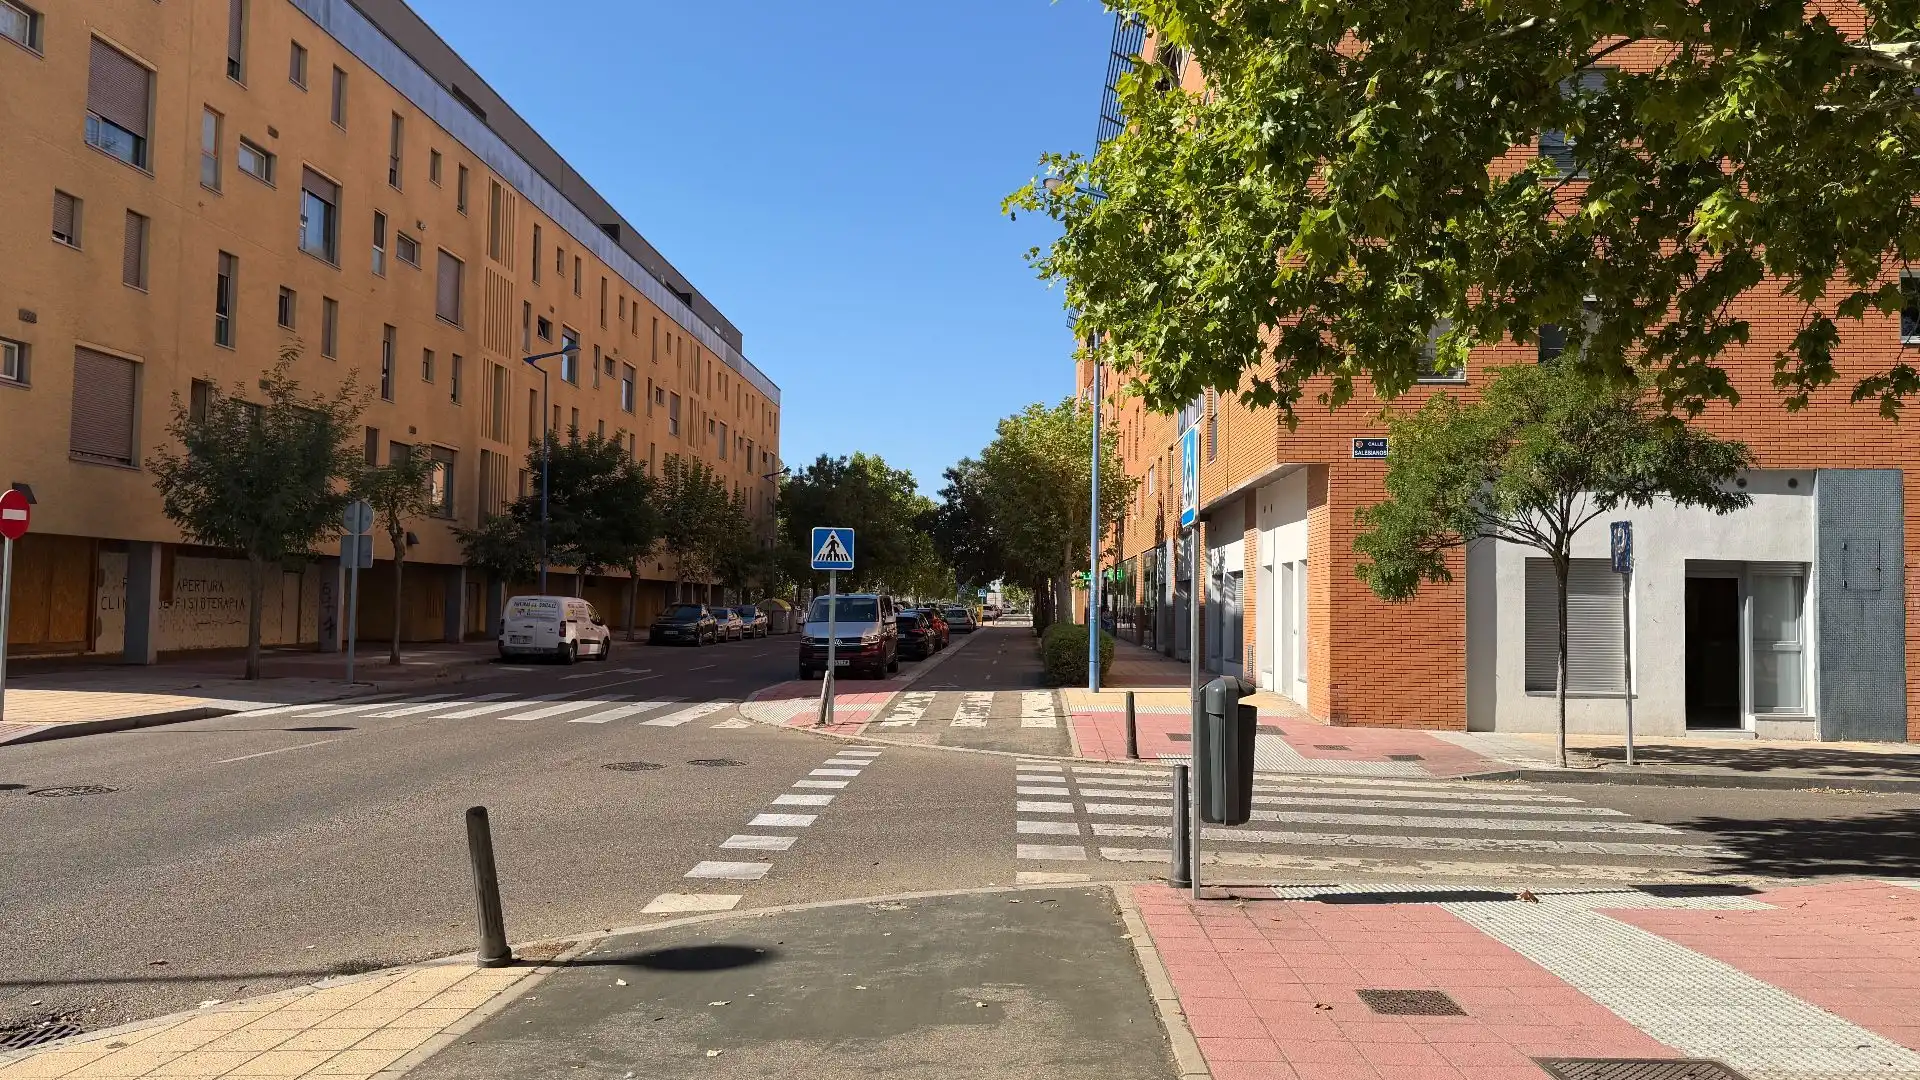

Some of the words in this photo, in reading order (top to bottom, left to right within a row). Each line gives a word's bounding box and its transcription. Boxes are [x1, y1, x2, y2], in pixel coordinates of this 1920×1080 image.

[176, 579, 224, 593] APERTURA
[101, 596, 127, 610] CLIN
[175, 597, 245, 612] FISIOTERAPIA
